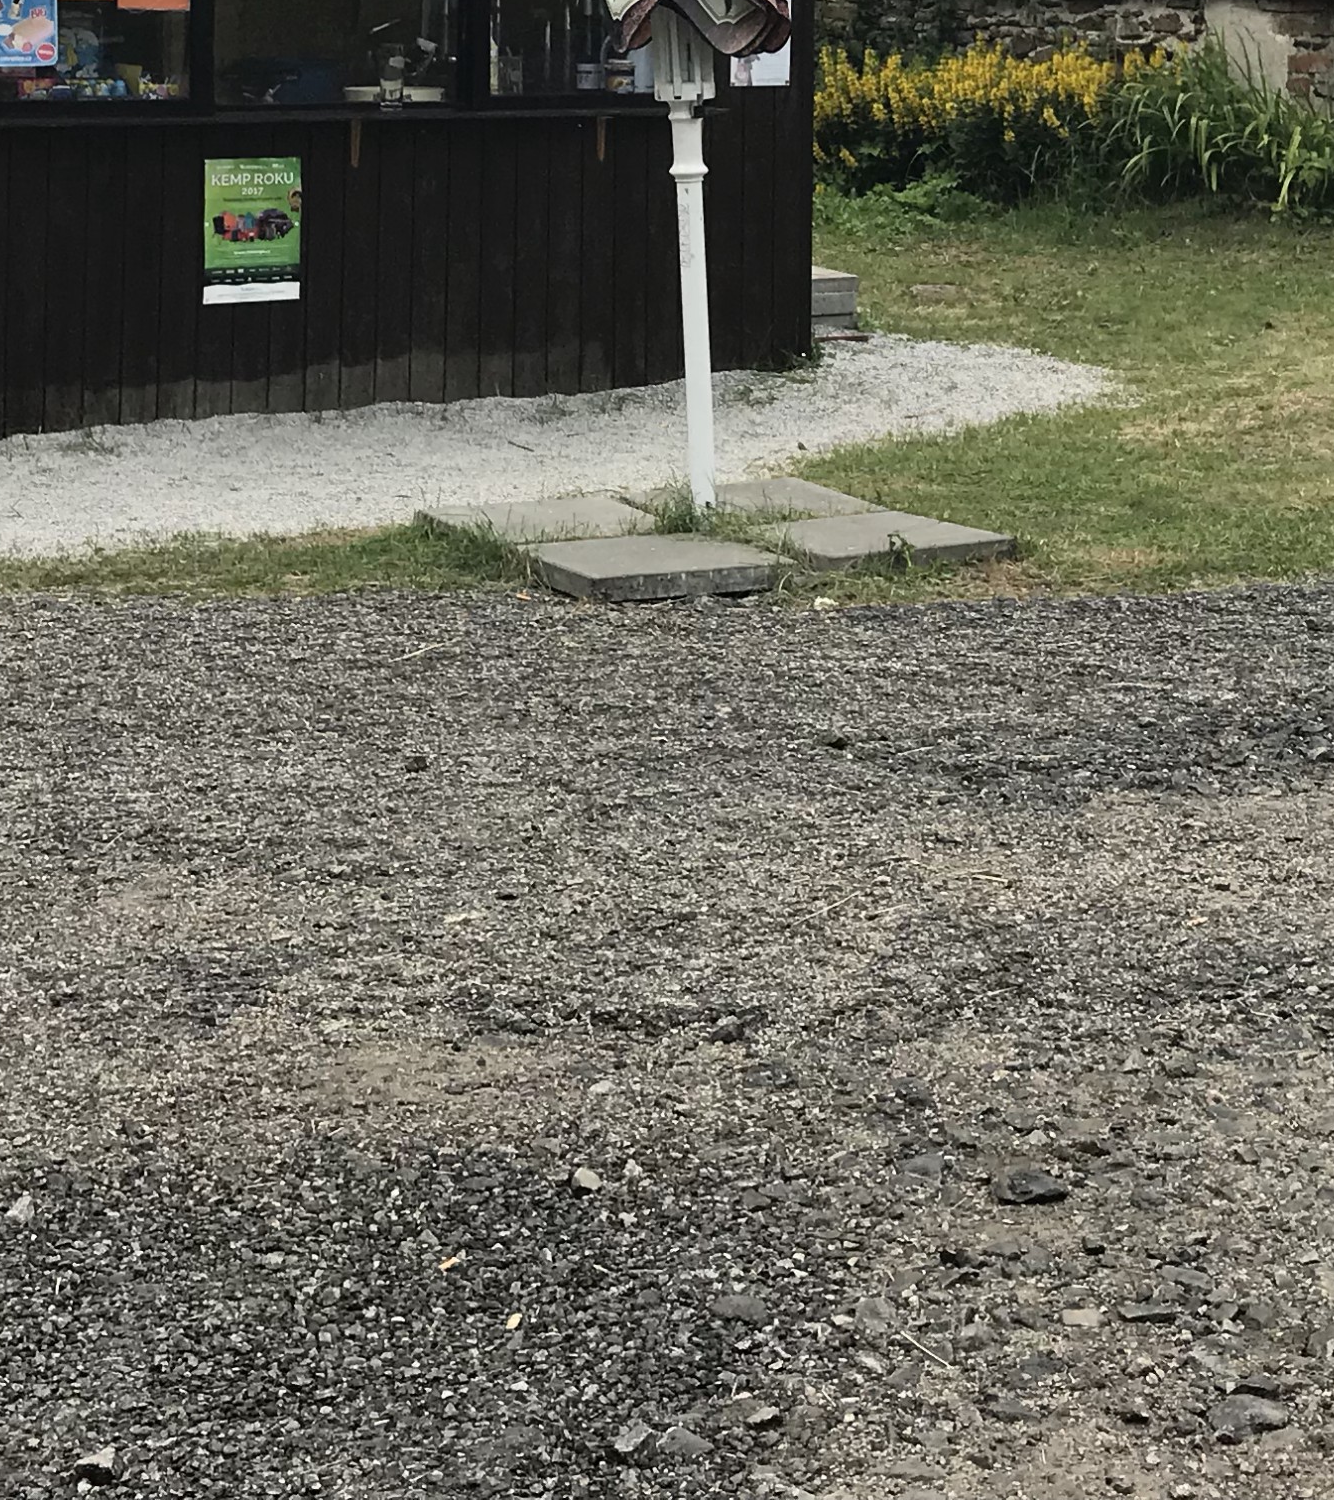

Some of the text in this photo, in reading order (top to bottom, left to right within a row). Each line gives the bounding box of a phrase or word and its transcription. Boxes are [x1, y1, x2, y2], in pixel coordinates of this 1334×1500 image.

[211, 171, 294, 186] KEMP ROKU
[241, 187, 264, 196] 2017
